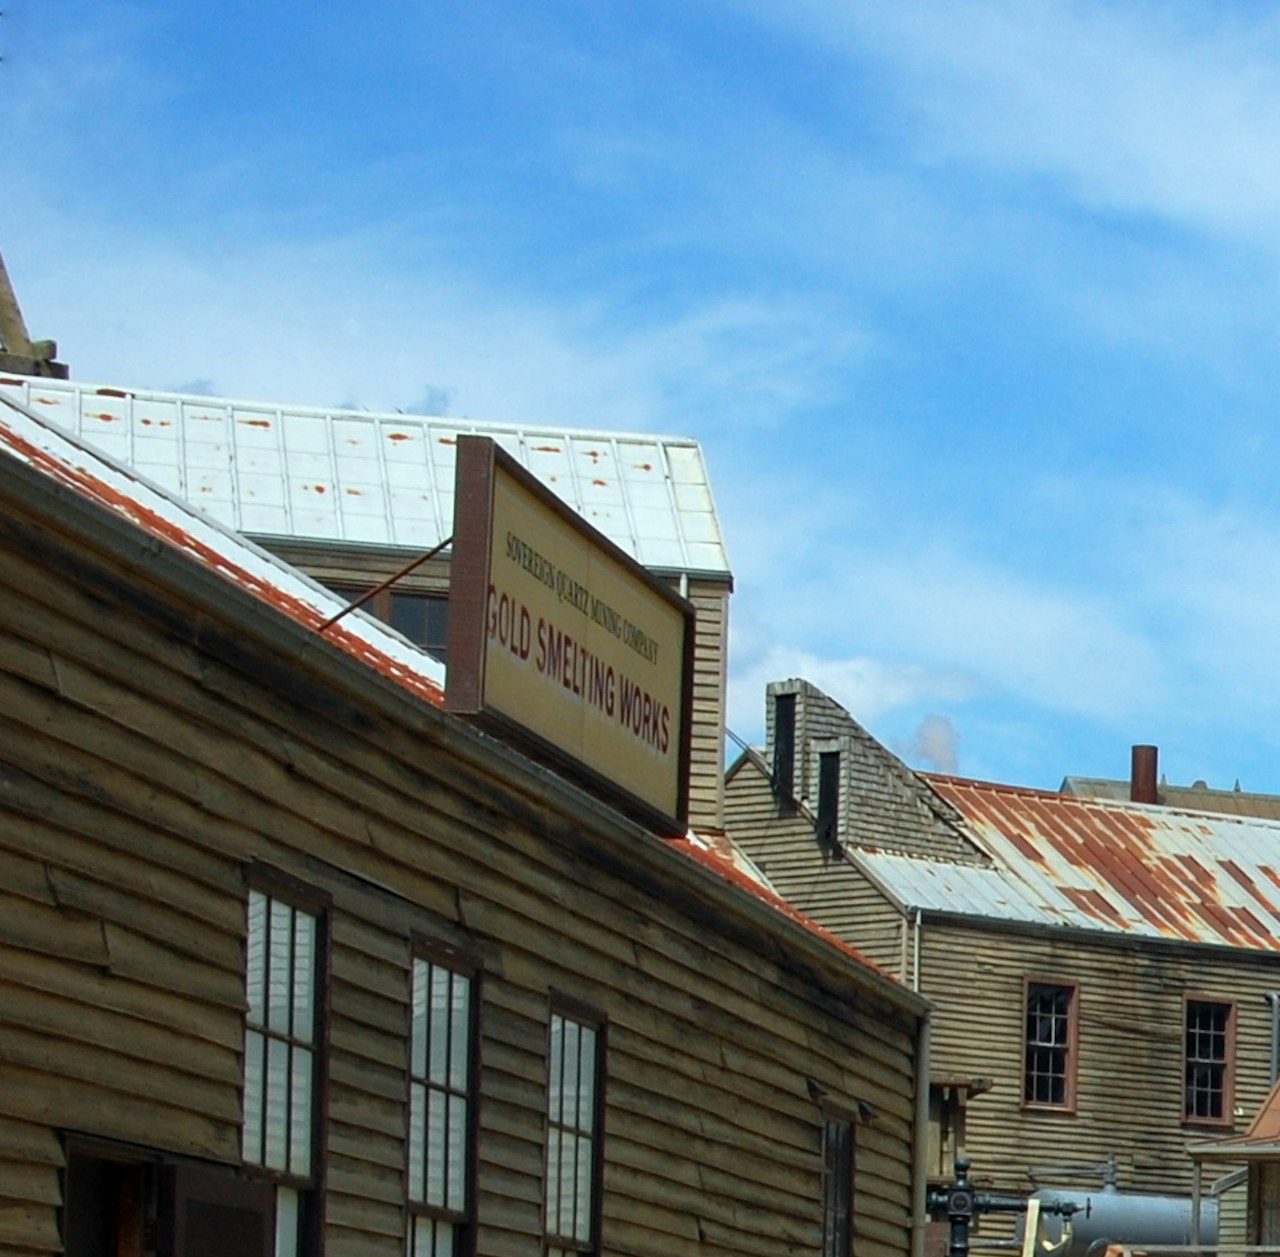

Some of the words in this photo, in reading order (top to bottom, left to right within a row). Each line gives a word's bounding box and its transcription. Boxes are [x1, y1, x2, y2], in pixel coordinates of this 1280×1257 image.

[487, 583, 531, 662] GOLD
[537, 616, 615, 718] SMELTING
[619, 675, 669, 755] WORKS
[506, 531, 556, 591] SOVEREIGN
[556, 569, 588, 617] QUARTZ
[590, 599, 621, 640] MINING
[623, 619, 659, 665] COMPANY
